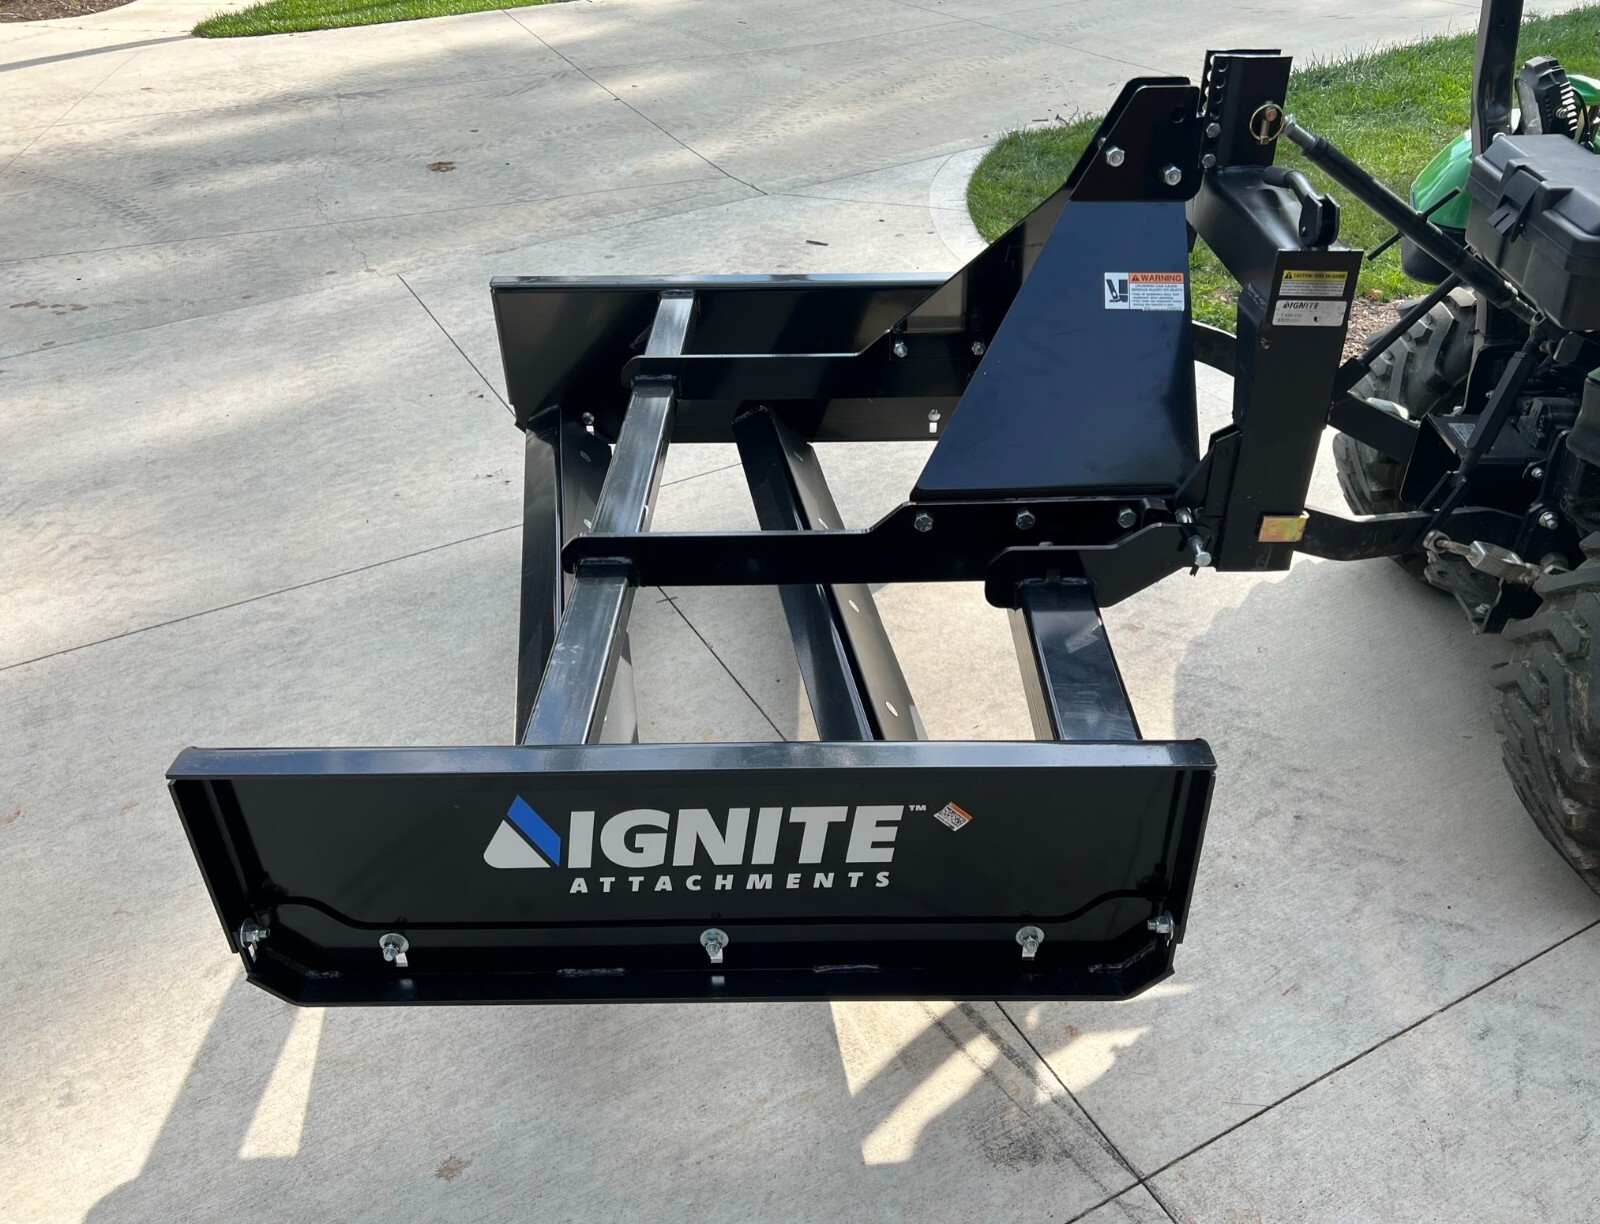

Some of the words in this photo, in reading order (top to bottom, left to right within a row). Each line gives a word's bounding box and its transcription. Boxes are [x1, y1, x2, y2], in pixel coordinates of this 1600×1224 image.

[1141, 274, 1182, 282] WARNING
[568, 805, 904, 868] IGNITE
[569, 871, 890, 894] ATTACHMENTS
